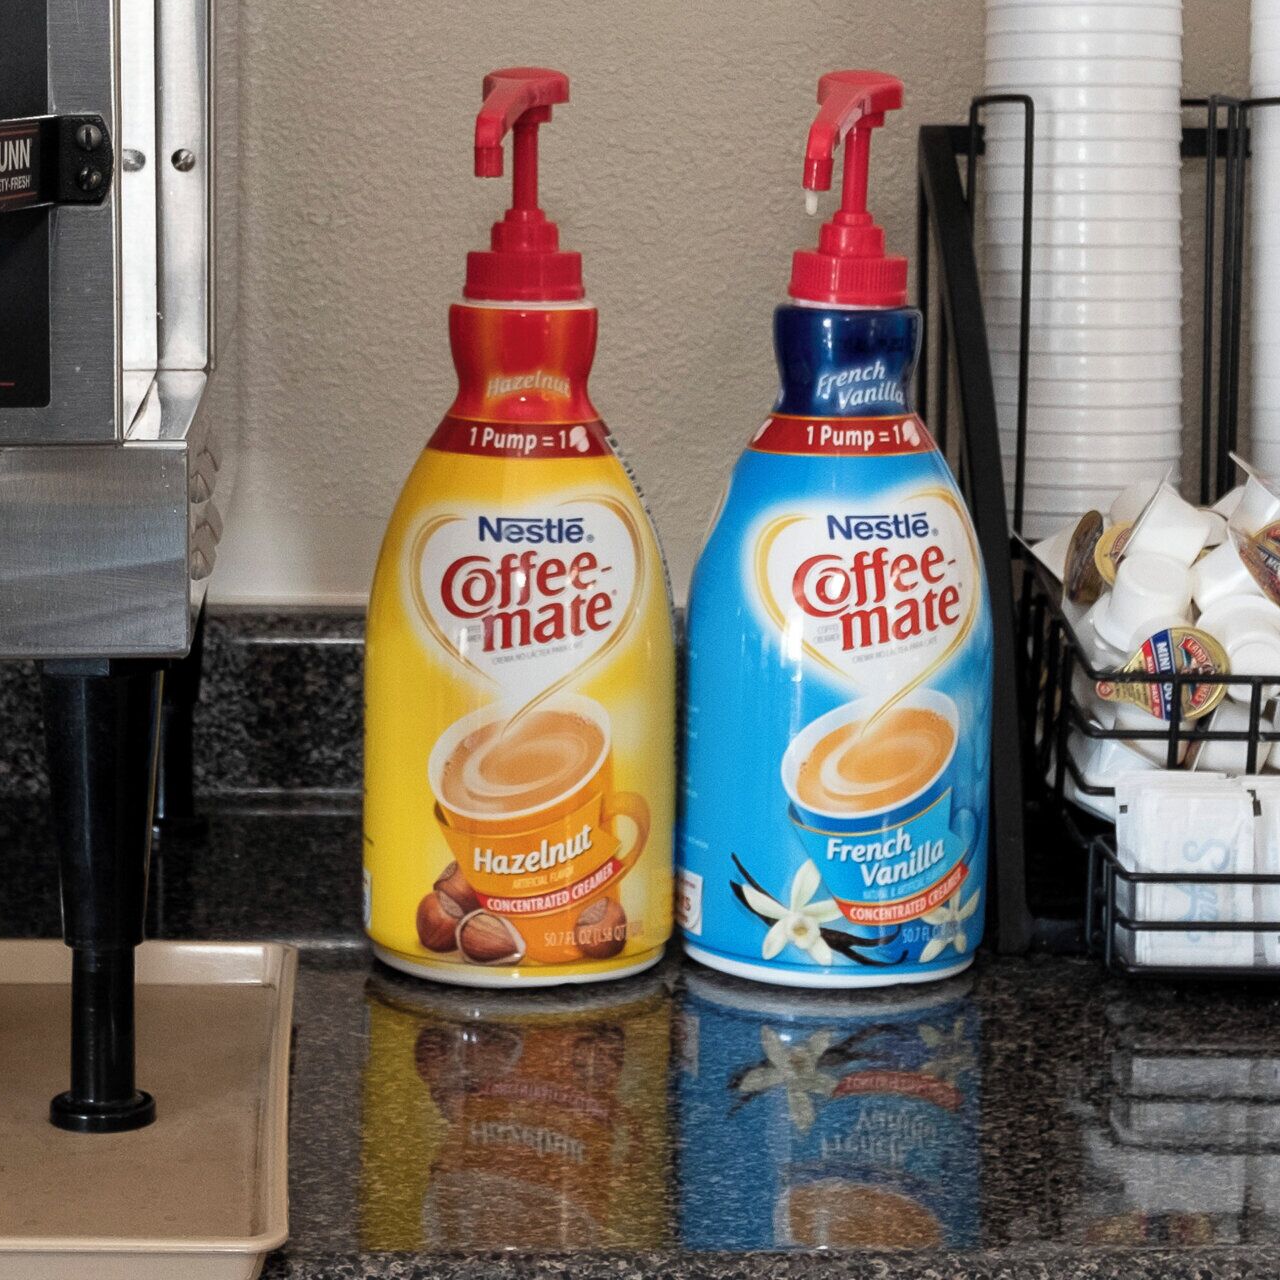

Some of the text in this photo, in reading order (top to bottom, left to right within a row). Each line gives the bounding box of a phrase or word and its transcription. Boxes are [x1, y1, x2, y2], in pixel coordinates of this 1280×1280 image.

[815, 360, 886, 400] French
[838, 381, 905, 410] Vanilla
[470, 426, 478, 447] 1
[481, 427, 538, 455] Pump
[559, 429, 566, 449] 1
[806, 425, 814, 445] 1
[820, 424, 875, 452] Pump
[481, 592, 613, 652] mate
[838, 584, 961, 652] mate
[1156, 641, 1171, 671] MINI
[473, 824, 593, 875] Hazelnut
[826, 827, 913, 863] French
[860, 838, 945, 888] Vanilla
[486, 862, 615, 913] CONCENTRATED CREAMER
[849, 897, 927, 922] CONCENTRATED
